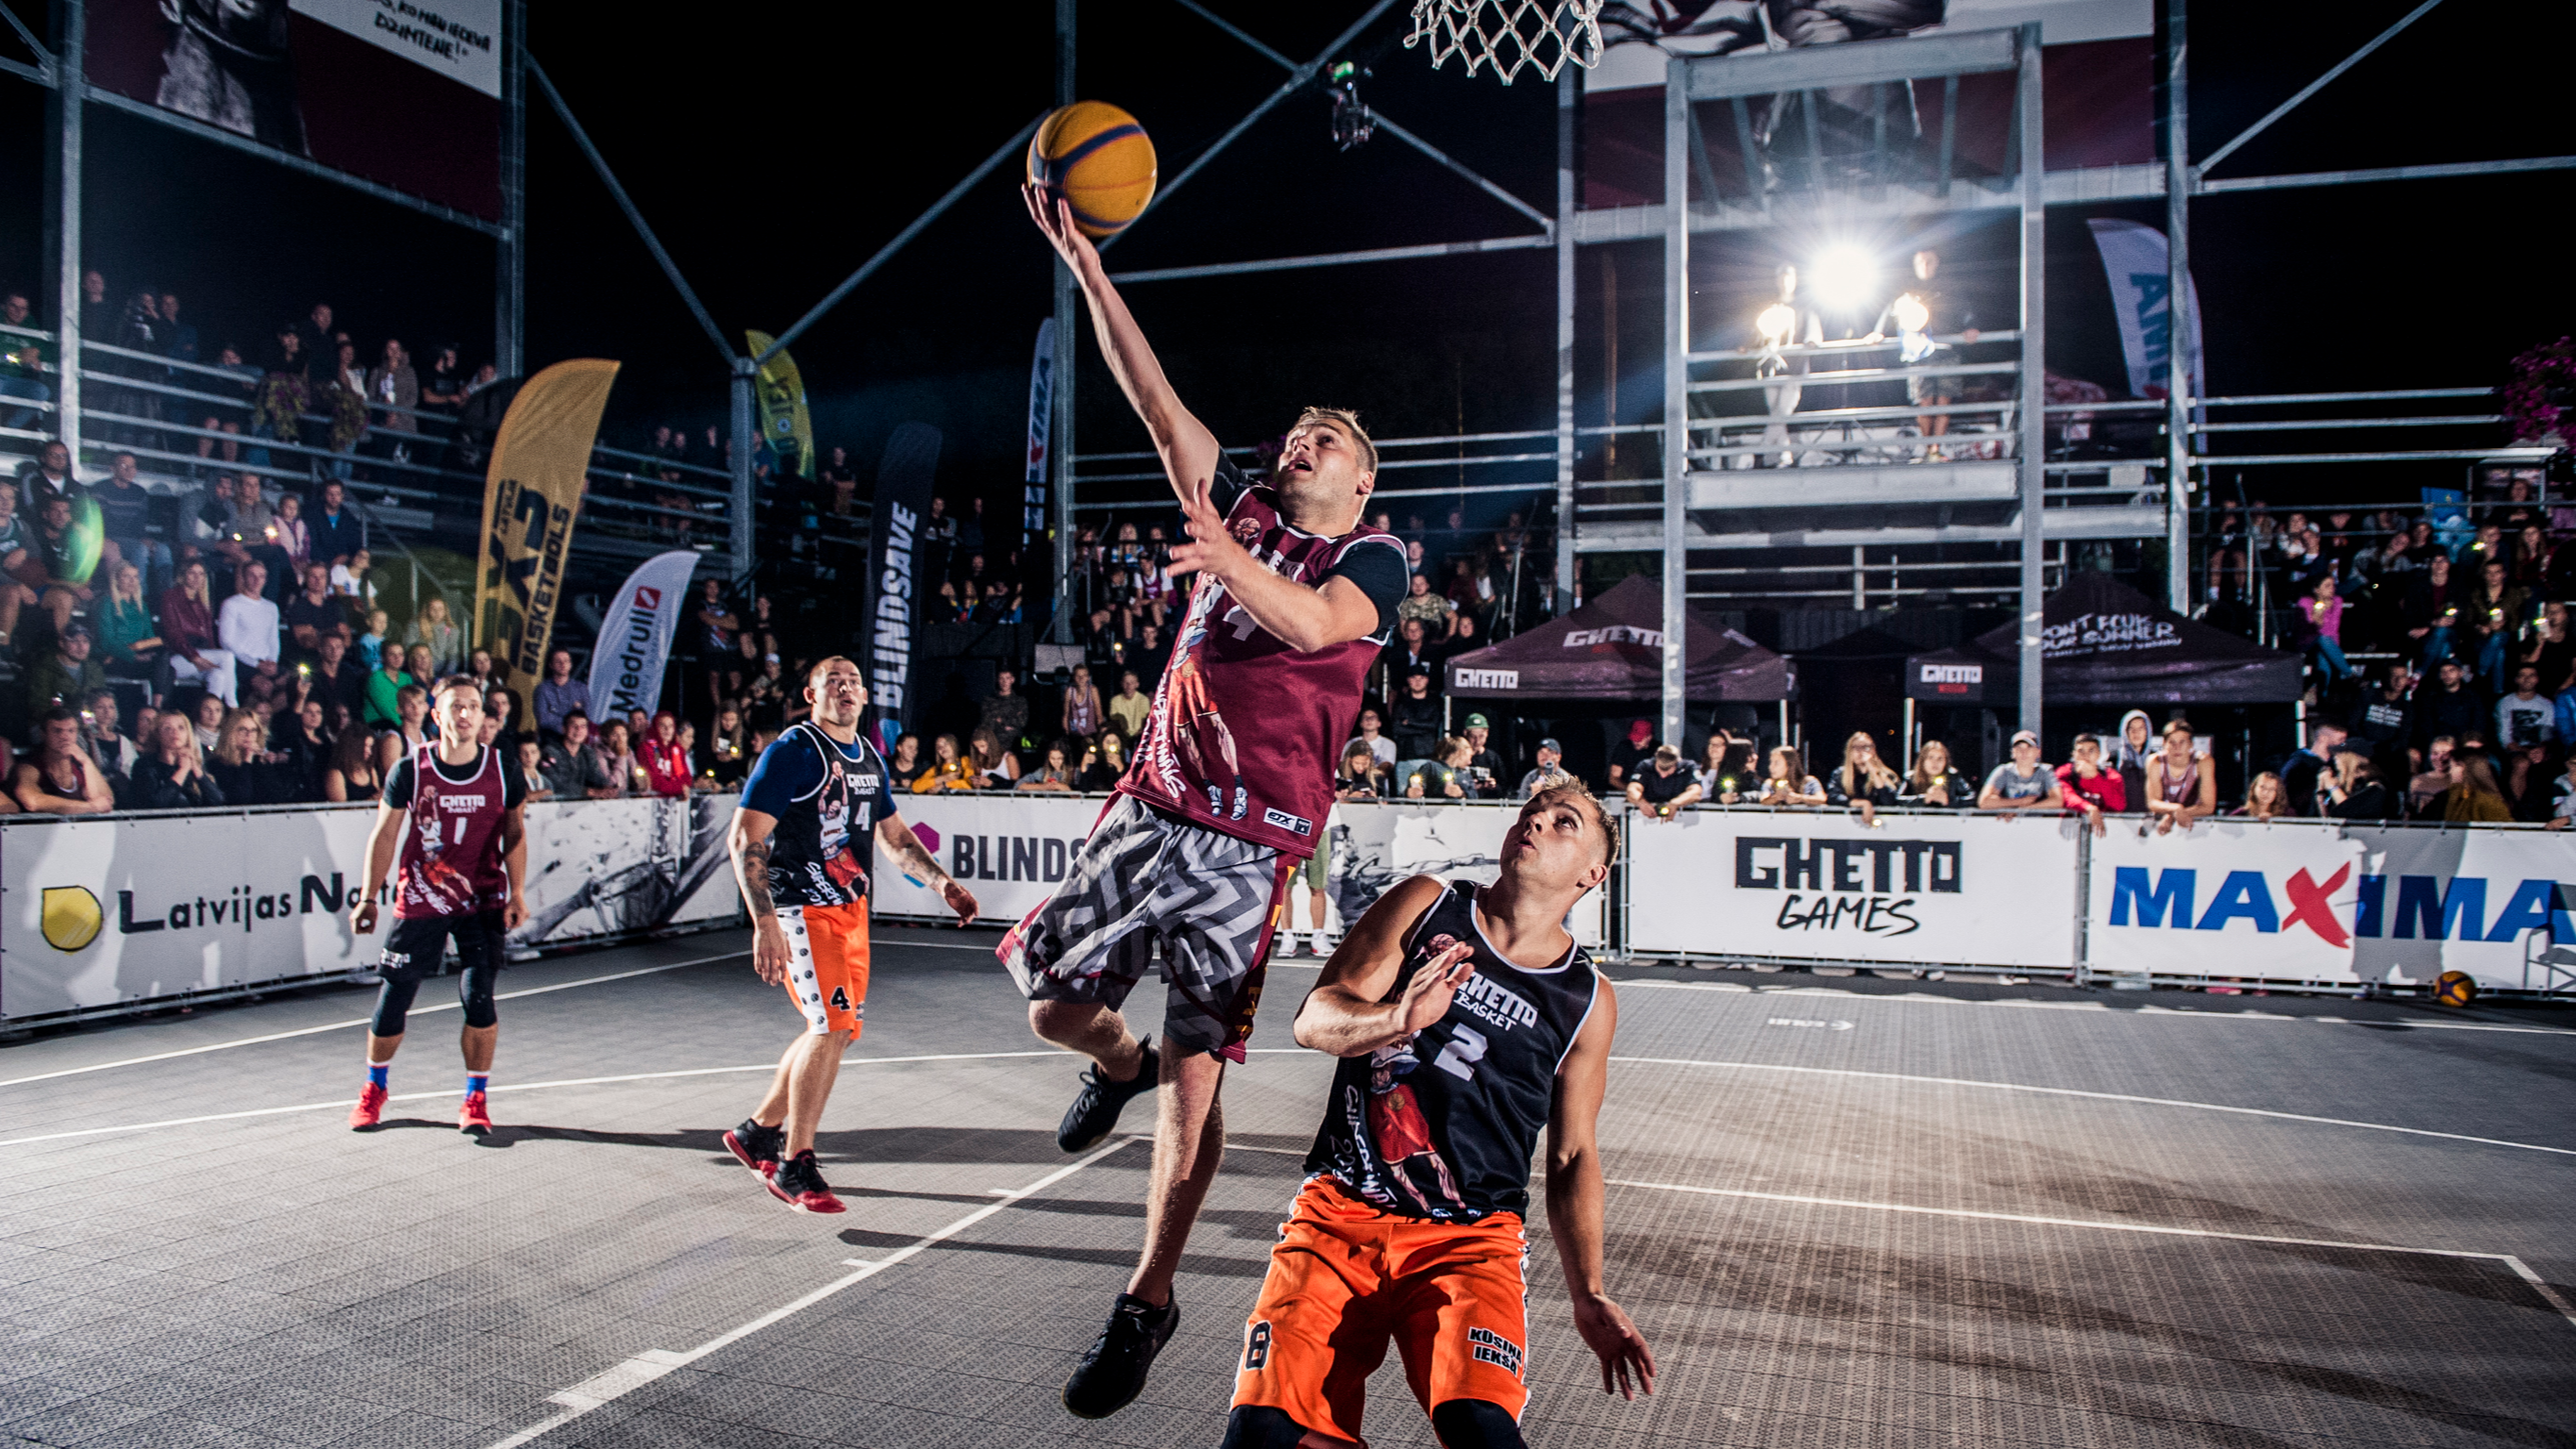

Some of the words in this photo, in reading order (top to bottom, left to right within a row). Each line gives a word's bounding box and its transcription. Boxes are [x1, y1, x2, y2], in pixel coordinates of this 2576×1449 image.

[520, 503, 571, 676] BASKETBOLS
[873, 501, 918, 708] BLINDSAVE
[609, 607, 656, 714] Medrull
[1455, 668, 1519, 690] GHETTO
[1921, 664, 1982, 684] GHETTO
[453, 817, 468, 845] 1
[854, 801, 871, 831] 4
[1734, 836, 1963, 893] GHETTO
[117, 884, 293, 934] Latvijas
[1776, 893, 1921, 939] GAMES
[2109, 859, 2576, 949] MAXIMA
[829, 986, 851, 1011] 4
[1452, 989, 1517, 1032] BASKET
[1433, 1022, 1489, 1082] 2
[1245, 1320, 1272, 1371] 8
